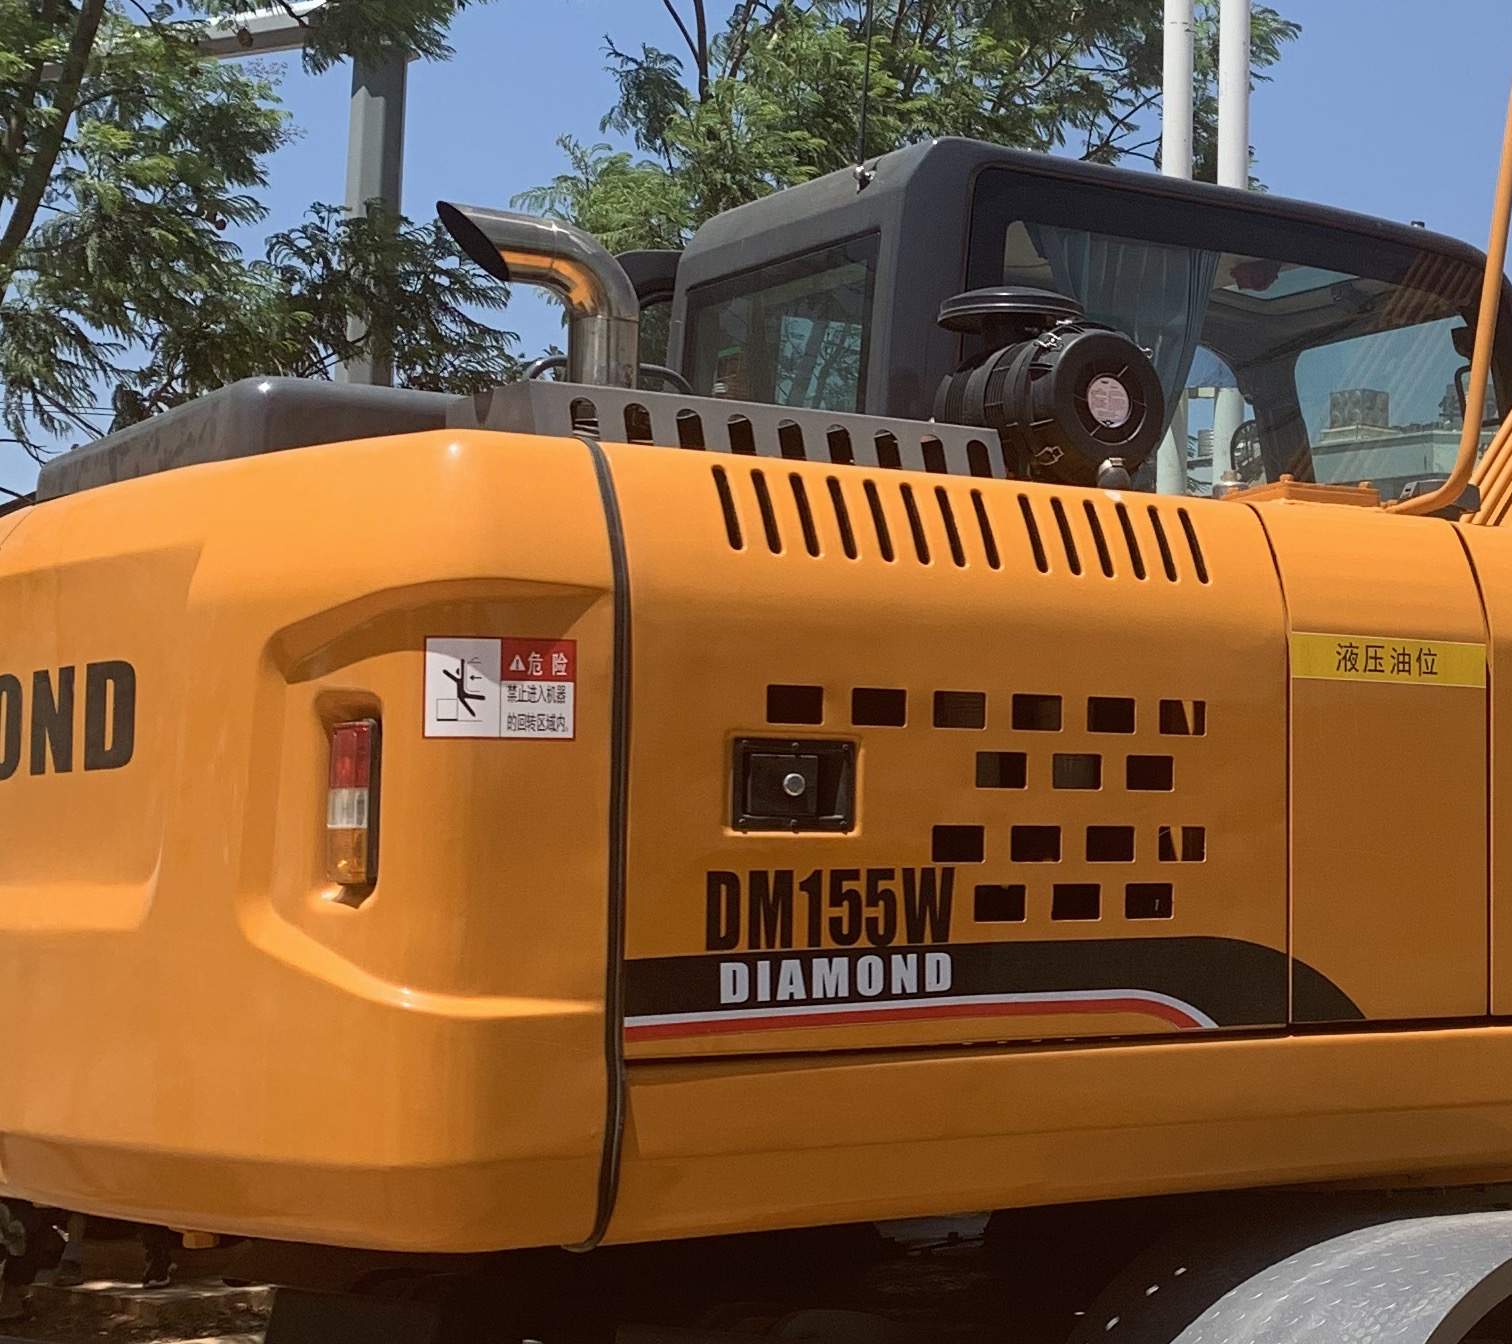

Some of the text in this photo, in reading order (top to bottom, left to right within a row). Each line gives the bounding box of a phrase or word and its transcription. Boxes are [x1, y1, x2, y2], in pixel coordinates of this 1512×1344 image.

[527, 651, 569, 676] 危险
[1335, 642, 1438, 676] 液压油位
[705, 867, 956, 951] DM155W
[719, 952, 952, 1004] DIAMOND
